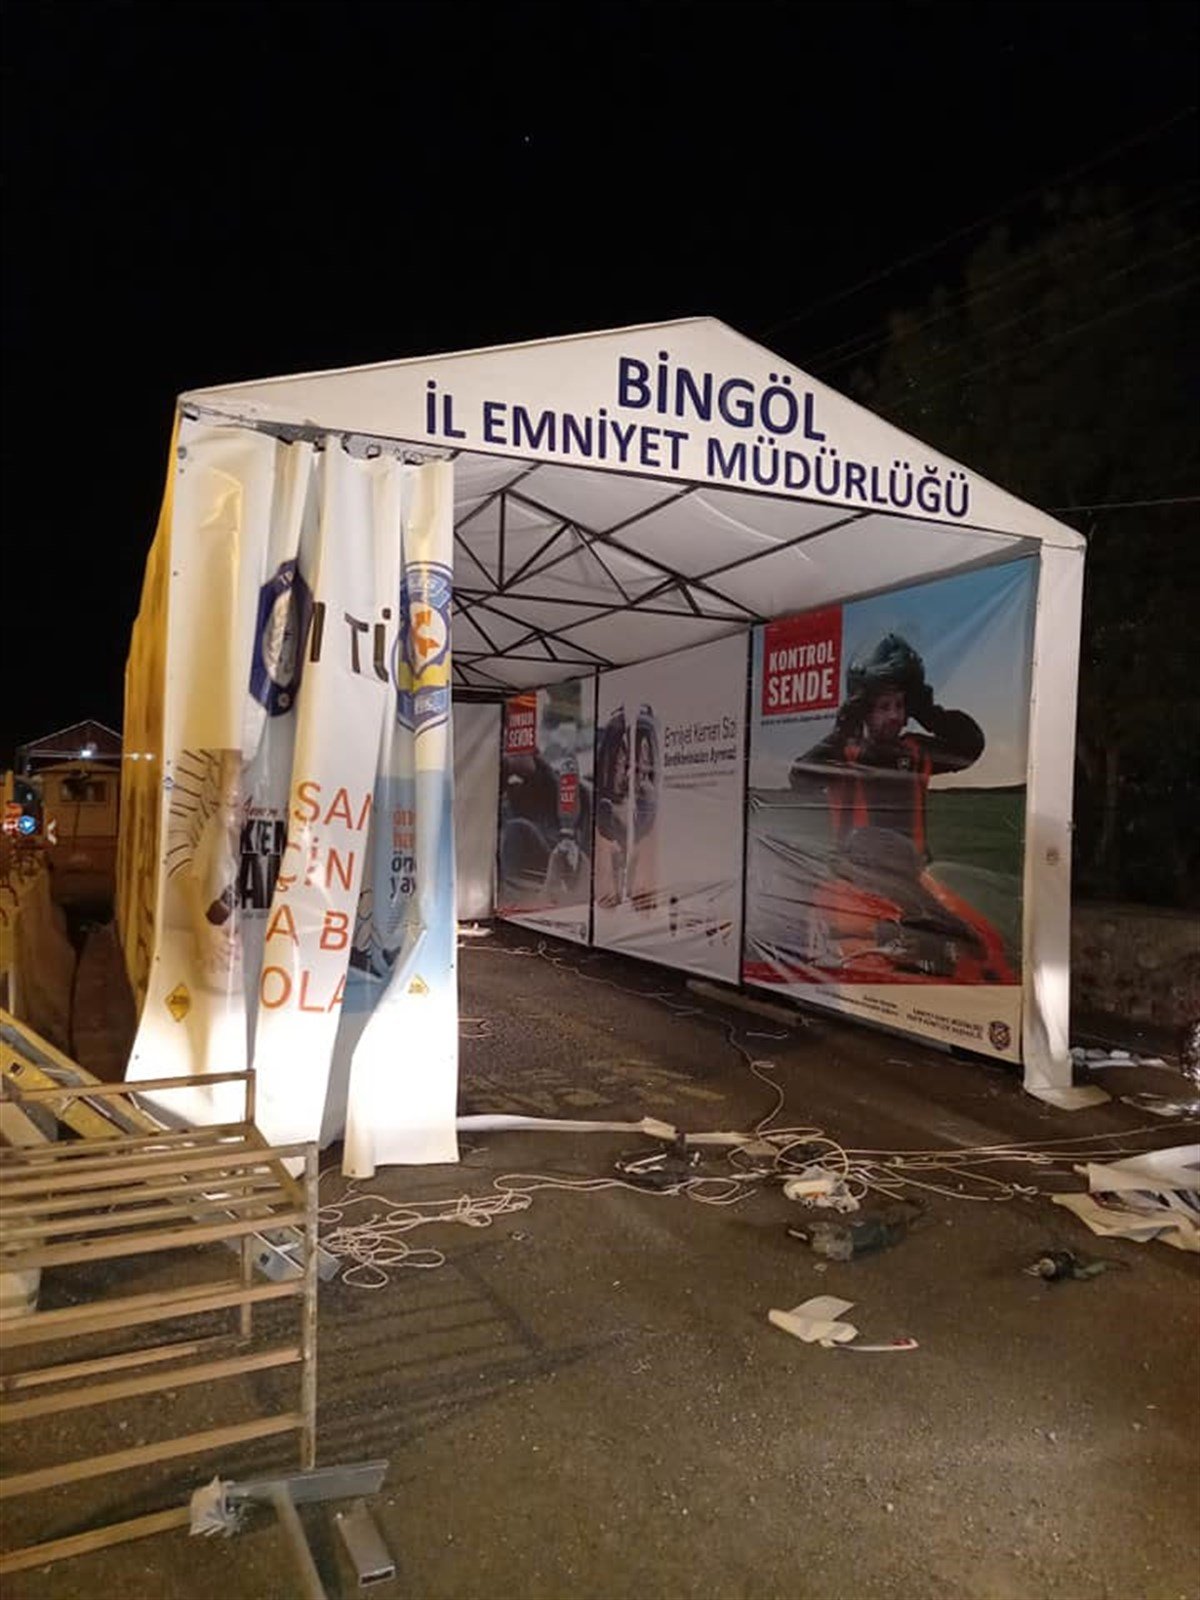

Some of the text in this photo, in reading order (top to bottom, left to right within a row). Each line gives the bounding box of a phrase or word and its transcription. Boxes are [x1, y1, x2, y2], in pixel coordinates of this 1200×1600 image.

[618, 351, 826, 442] BİNGÖL
[426, 380, 971, 518] İL EMNİYET MÜDÜRLÜĞÜ
[768, 640, 835, 673] KONTROL
[768, 668, 834, 707] SENDE
